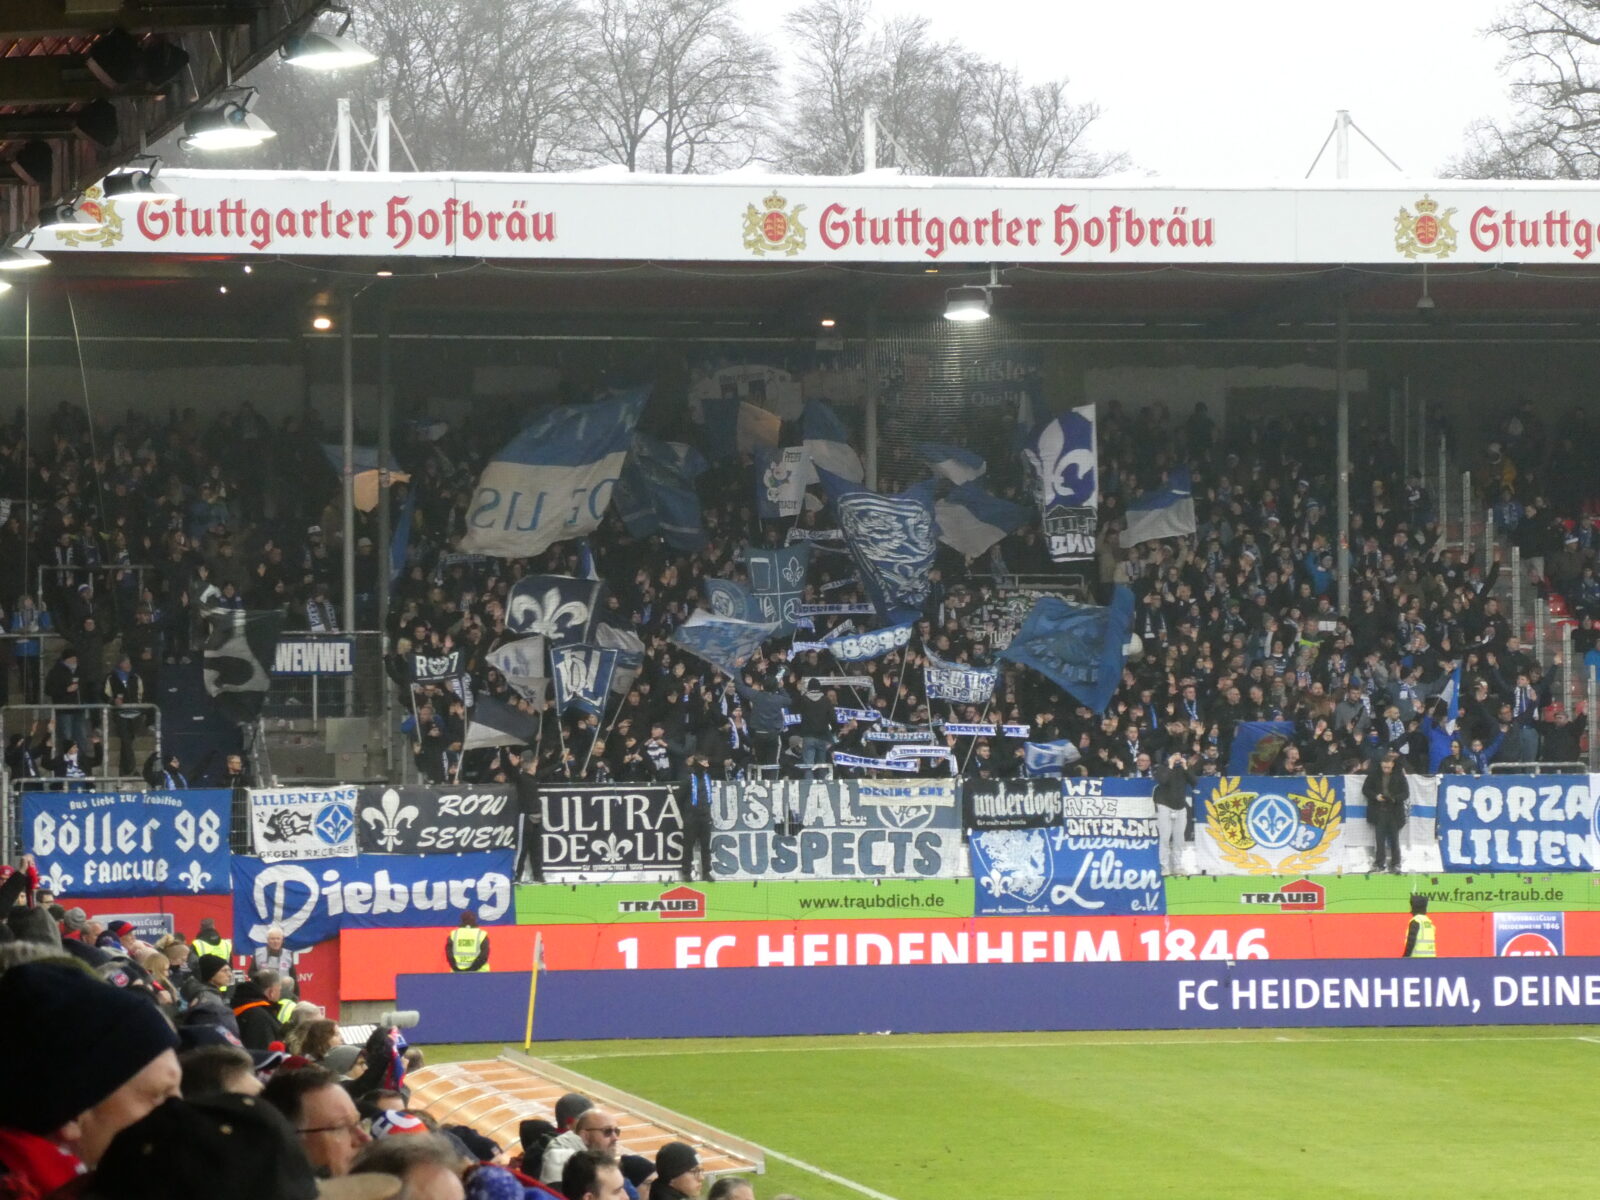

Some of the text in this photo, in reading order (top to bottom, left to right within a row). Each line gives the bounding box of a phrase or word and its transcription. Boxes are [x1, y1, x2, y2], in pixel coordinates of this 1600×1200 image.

[136, 195, 558, 251] Stuttgarter Hofbräu
[819, 202, 1215, 259] Stuttgarter Hofbräu
[1470, 206, 1600, 260] Stuttg
[253, 789, 357, 806] LILIENFANS
[438, 794, 508, 817] ROW
[973, 781, 1061, 823] underdogs
[1064, 778, 1103, 796] WE
[1446, 785, 1591, 823] FORZA
[1065, 797, 1118, 817] ARE
[33, 809, 221, 856] Böller 98
[417, 826, 514, 849] SEVEN
[541, 831, 684, 863] DE LIS
[1447, 829, 1595, 867] LILIEN
[711, 830, 943, 876] SUSPECTS
[1051, 850, 1162, 909] Lilien
[1242, 893, 1317, 903] TRAUB
[248, 865, 512, 943] Dieburg
[620, 900, 697, 911] TRAUB
[799, 893, 945, 910] www.traubdich.de
[1131, 892, 1160, 911] e.V.
[675, 935, 737, 969] FC
[756, 930, 1122, 967] HEIDENHEIM
[1139, 928, 1269, 961] 1846
[1179, 975, 1600, 1013] FC HEIDENHEIM, DEINE
